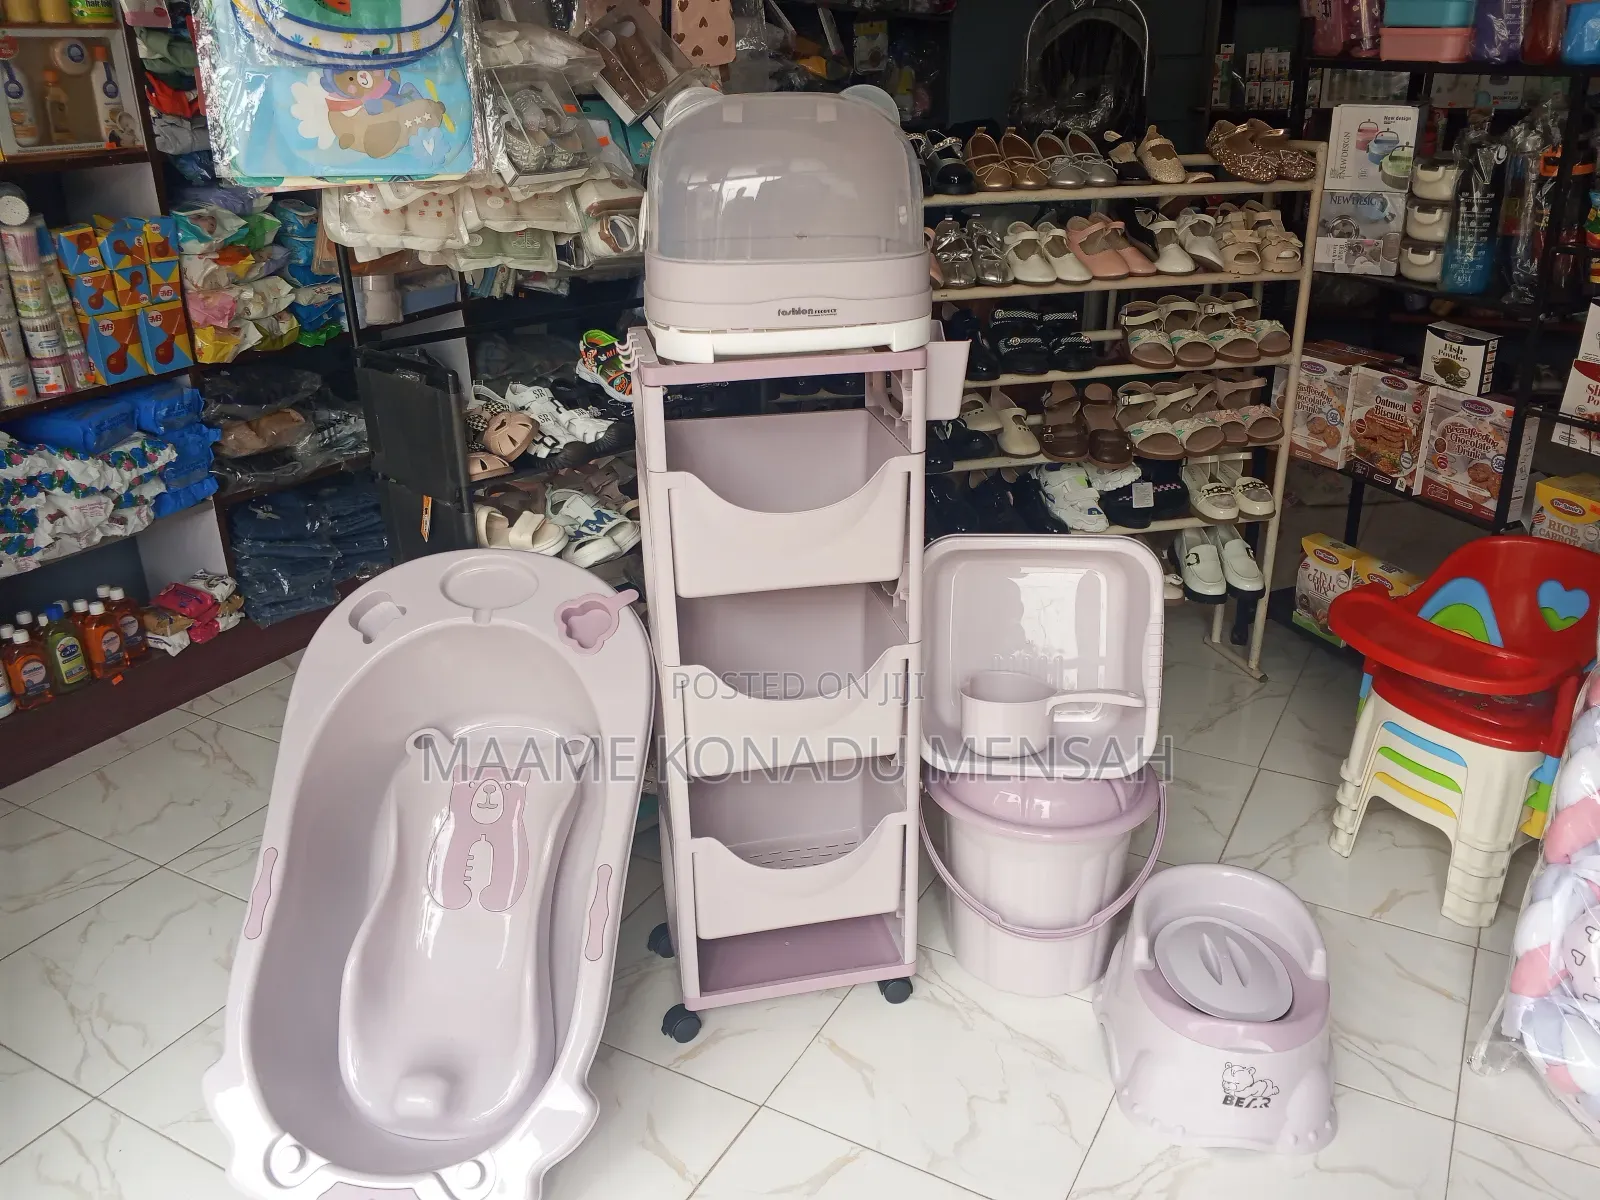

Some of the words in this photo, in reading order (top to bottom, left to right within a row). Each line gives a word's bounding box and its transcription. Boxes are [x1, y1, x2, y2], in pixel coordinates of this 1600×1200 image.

[1330, 195, 1350, 205] NEW
[778, 306, 814, 316] fashion
[1438, 348, 1468, 362] Powder
[1444, 342, 1464, 355] Fish
[532, 388, 546, 399] SR
[1375, 395, 1406, 412] Oatmeal
[538, 413, 551, 424] SR
[1374, 405, 1405, 423] Biscuits
[1445, 424, 1499, 449] Breastfeeding
[1450, 432, 1492, 452] Chocolate
[1456, 445, 1482, 461] Drink
[1222, 1094, 1272, 1108] BEAR
